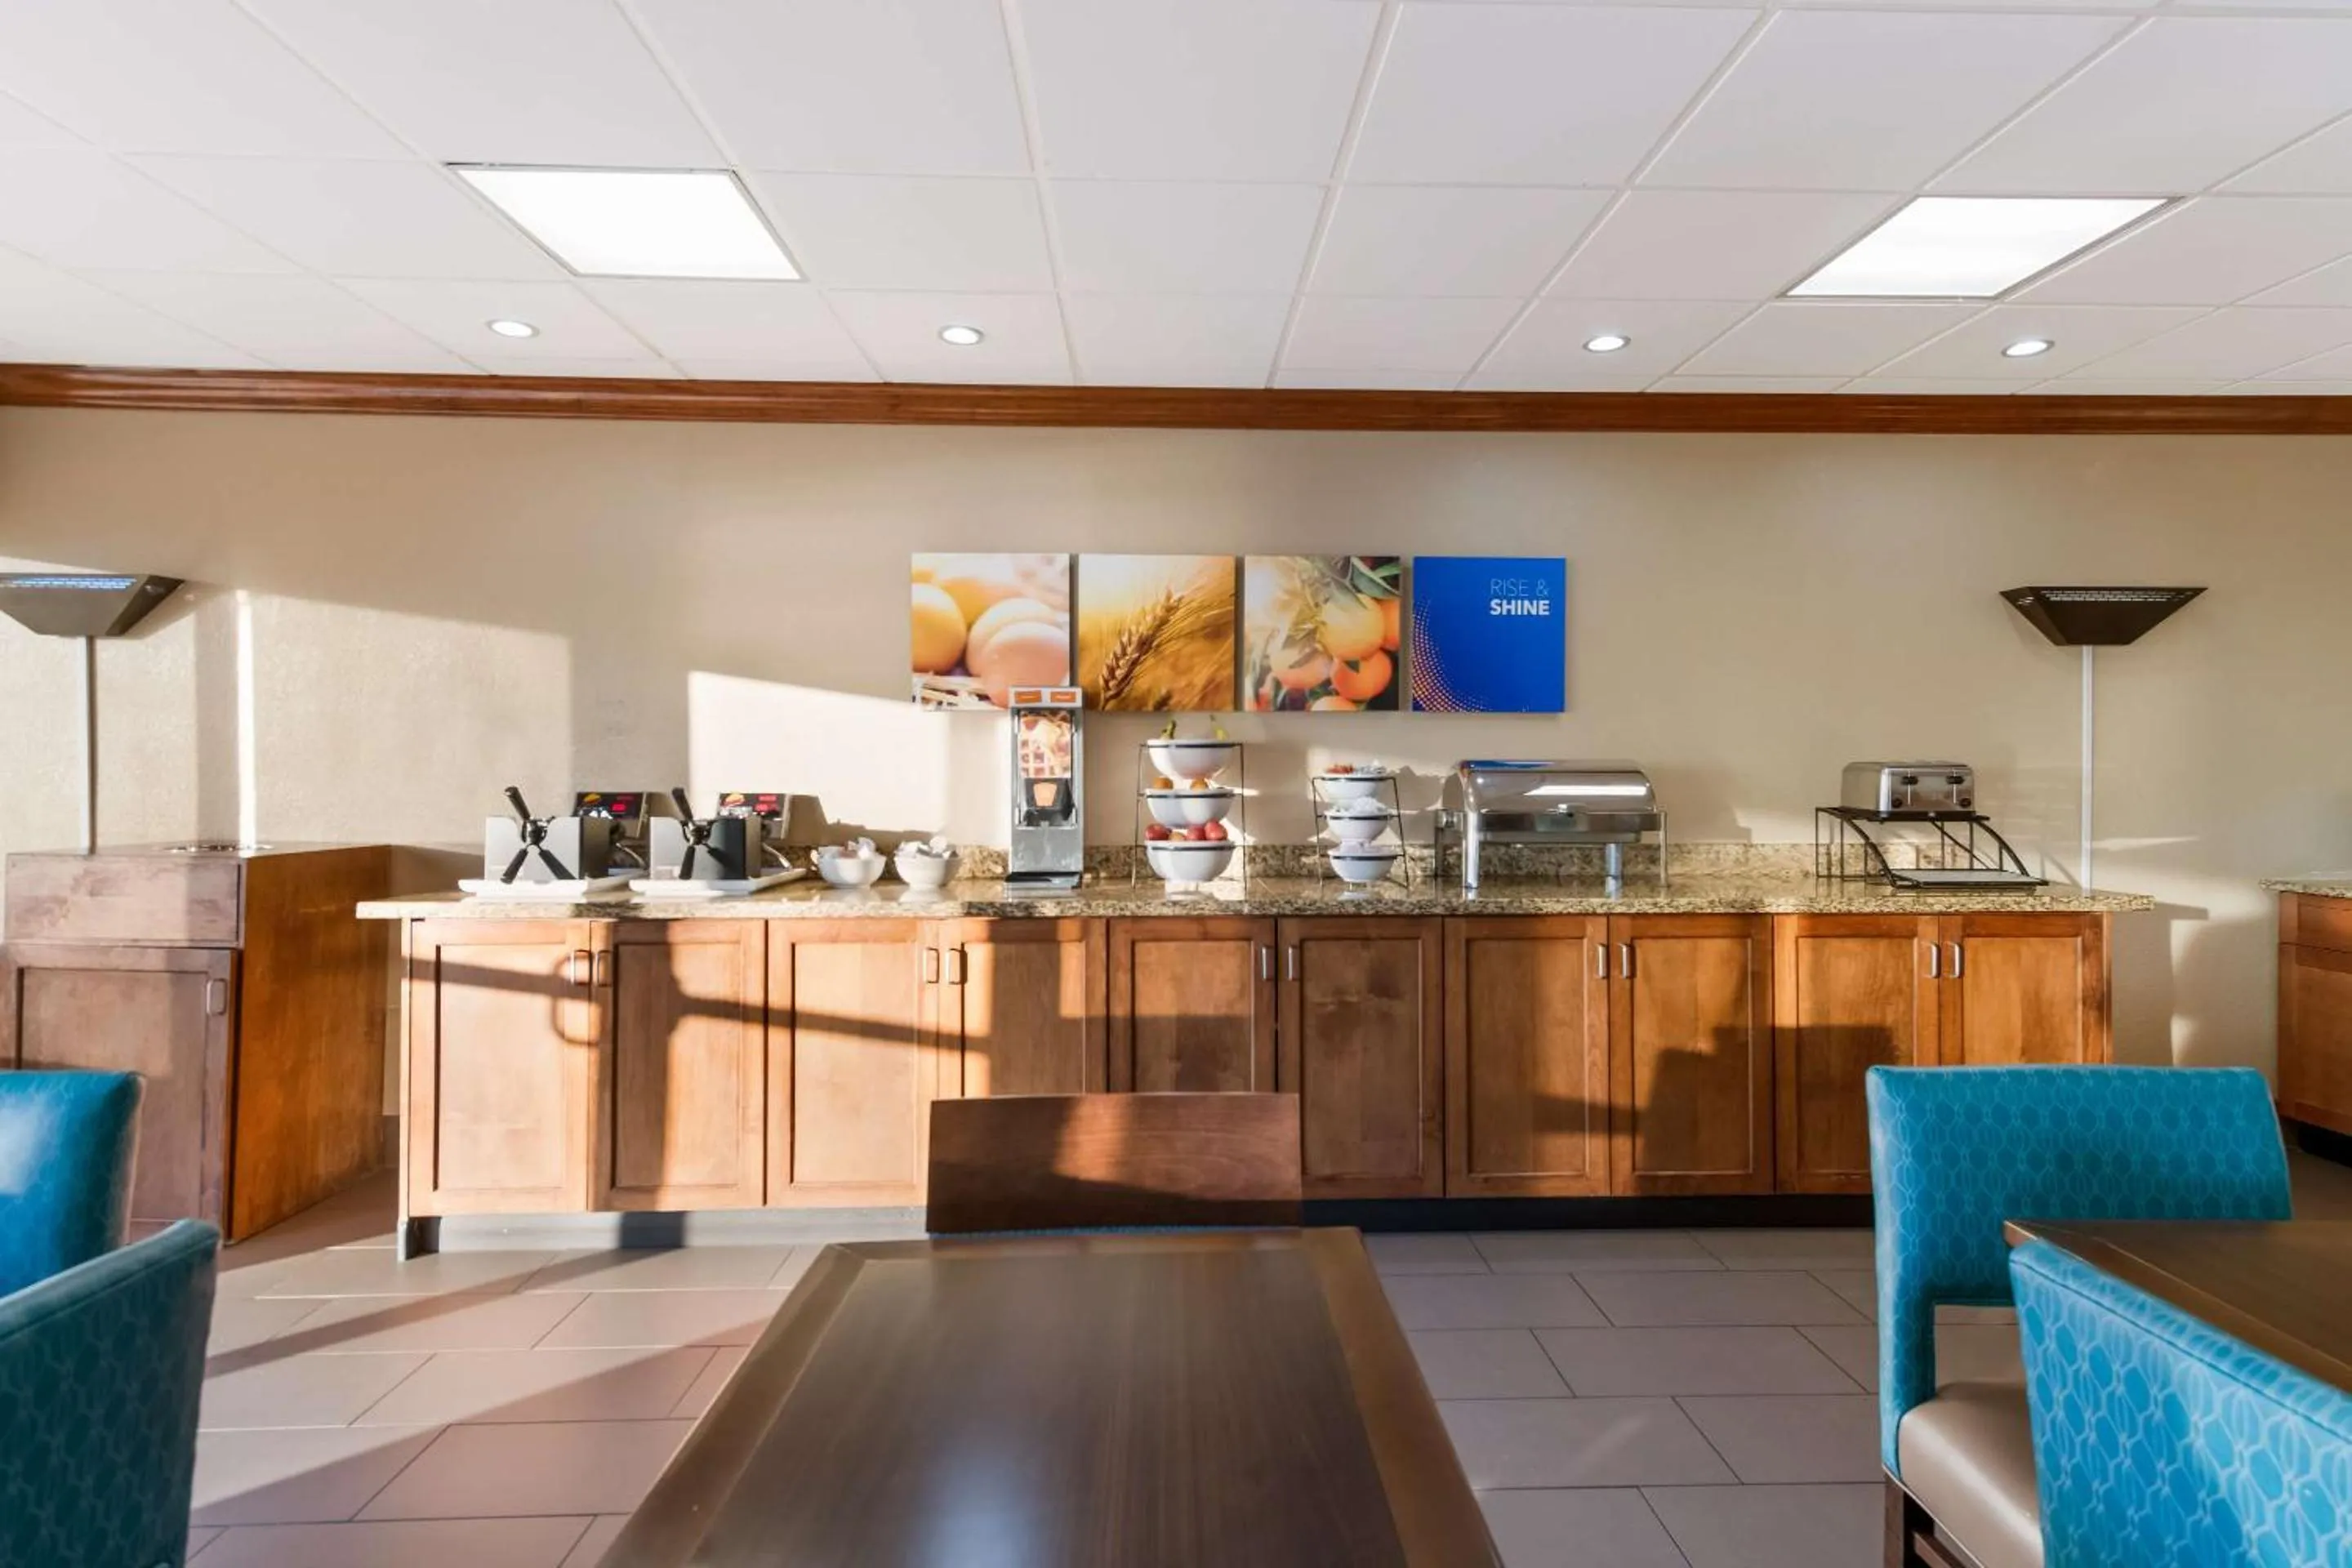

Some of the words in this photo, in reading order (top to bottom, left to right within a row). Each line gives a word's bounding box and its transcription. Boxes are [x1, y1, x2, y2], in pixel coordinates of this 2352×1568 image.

[1490, 578, 1529, 596] RISE
[1535, 578, 1550, 596] &
[1490, 599, 1551, 616] SHINE
